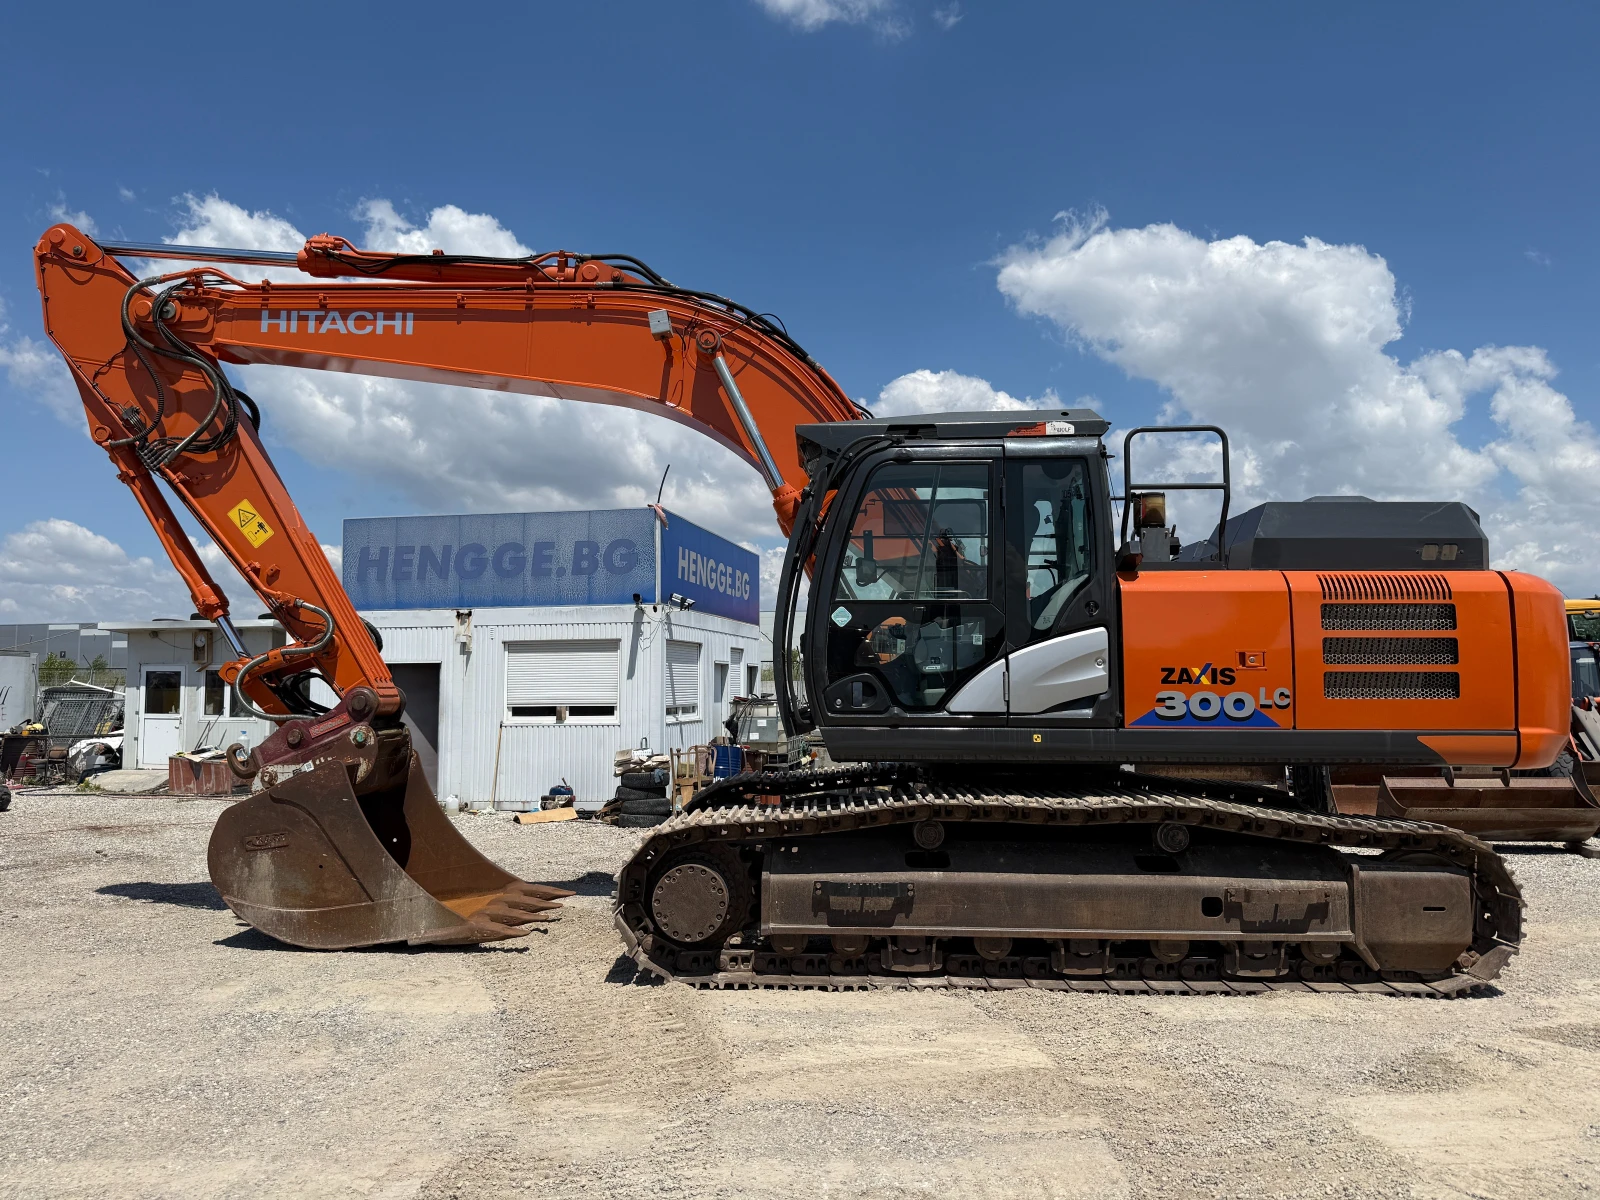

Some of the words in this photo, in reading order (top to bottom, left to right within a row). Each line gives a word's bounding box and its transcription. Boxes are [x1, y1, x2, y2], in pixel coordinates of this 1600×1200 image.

[260, 310, 414, 335] HITACHI
[357, 537, 640, 583] HENGGE.BG
[677, 545, 751, 601] HENGGE.BG
[1160, 662, 1236, 686] ZAXIS
[1154, 690, 1256, 722] 300
[1258, 686, 1291, 710] LC
